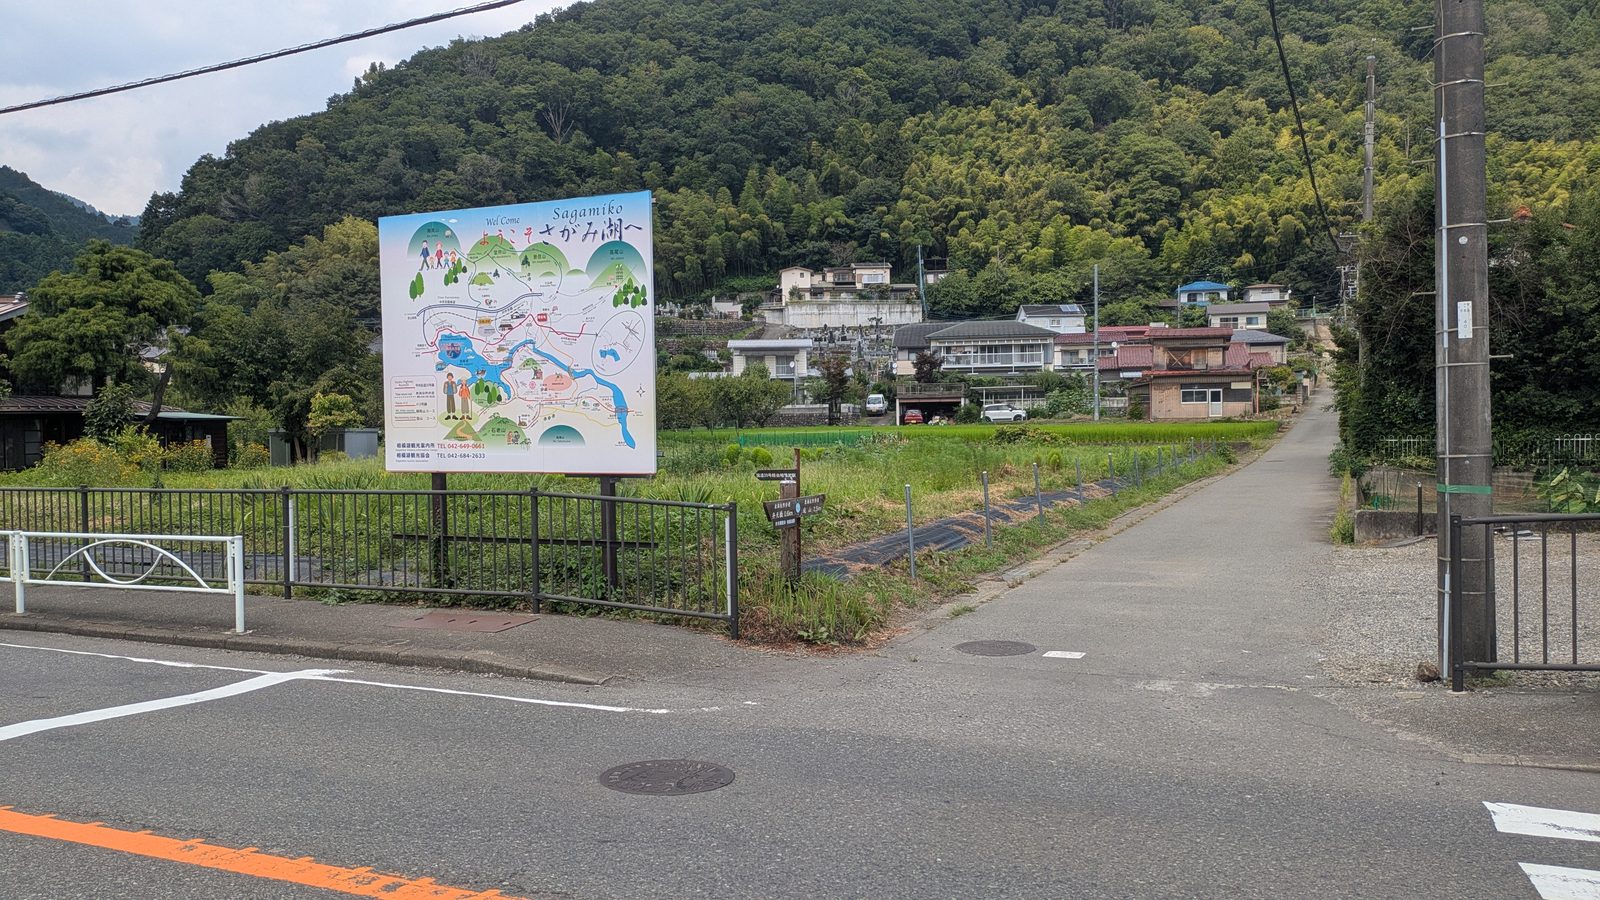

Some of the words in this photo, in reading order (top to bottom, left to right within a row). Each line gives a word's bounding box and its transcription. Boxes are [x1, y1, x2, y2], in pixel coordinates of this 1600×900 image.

[552, 199, 623, 224] Sagamiko
[486, 216, 500, 226] Wel
[500, 216, 520, 225] Come
